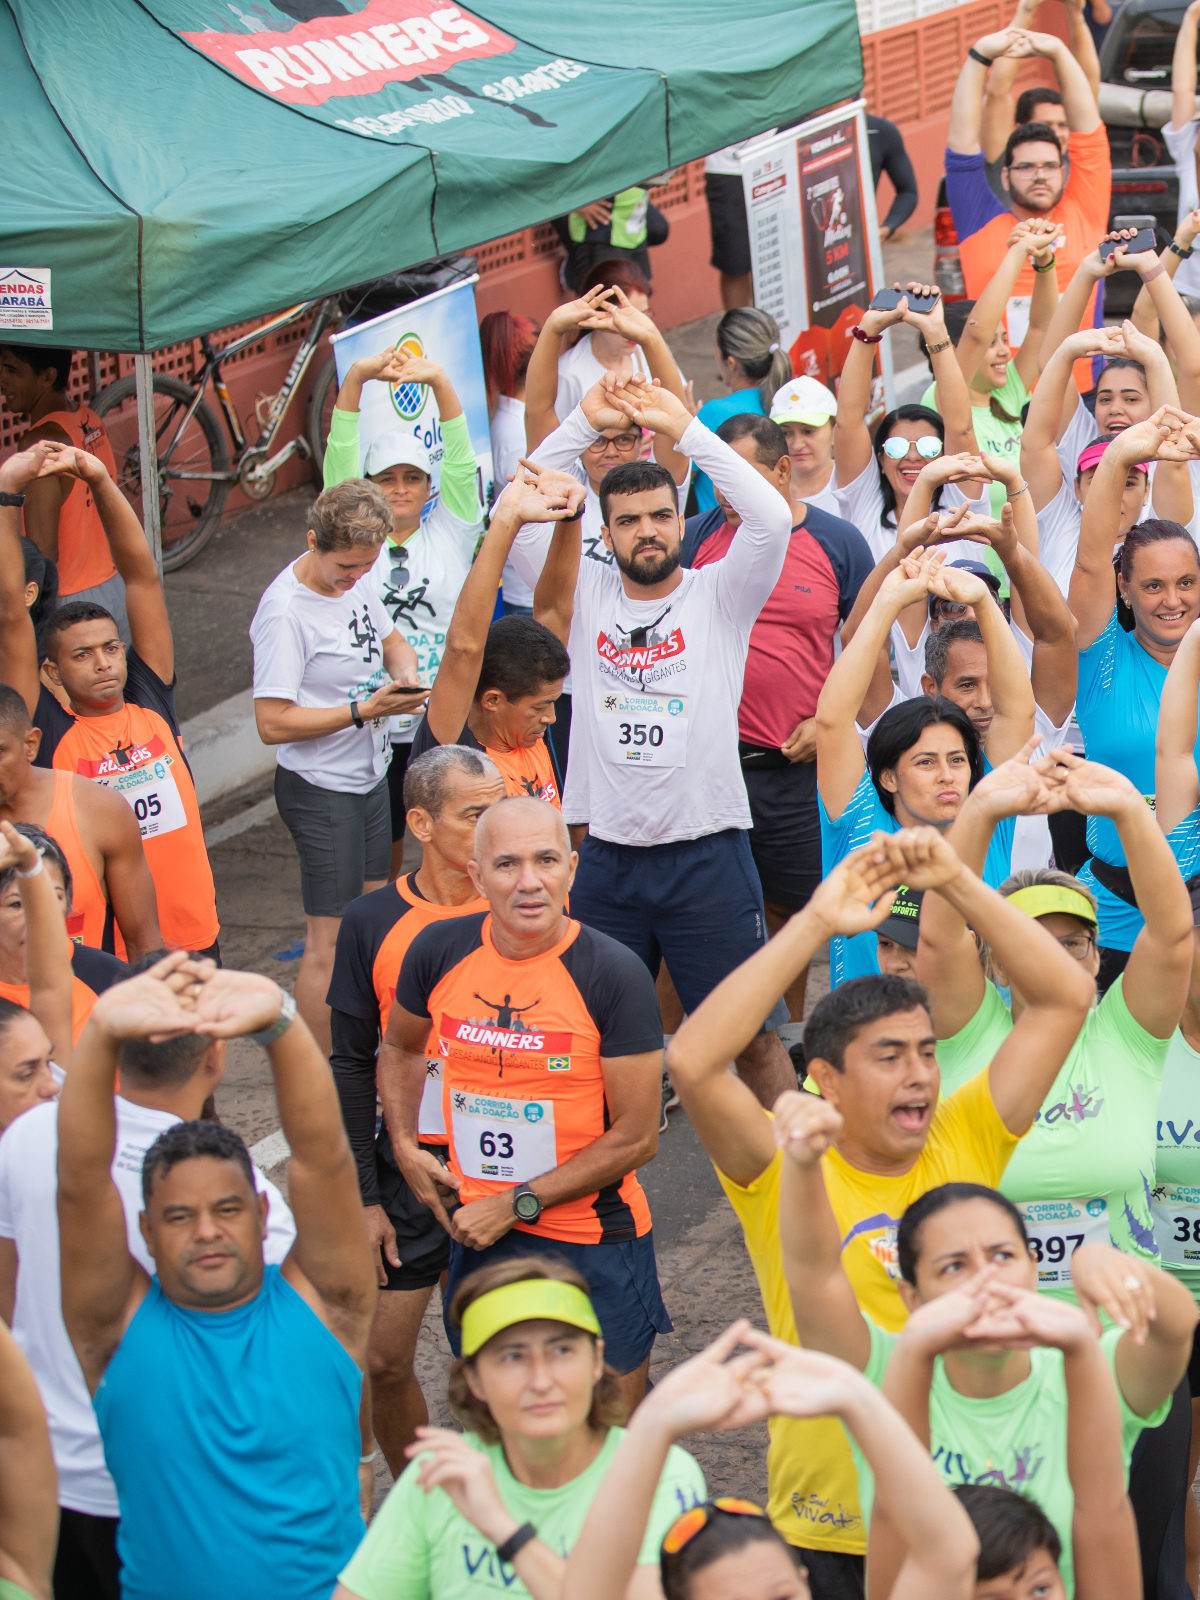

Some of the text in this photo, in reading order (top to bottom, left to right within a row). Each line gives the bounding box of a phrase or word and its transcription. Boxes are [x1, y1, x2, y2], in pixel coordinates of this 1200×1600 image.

[234, 7, 490, 92] RUNNERS
[0, 284, 44, 295] ENDAS
[0, 296, 46, 307] ARABÁ
[644, 659, 687, 684] GIGANTES
[624, 697, 659, 706] CORRIDA
[630, 703, 664, 714] DOAÇÃO
[618, 722, 664, 748] 350
[118, 769, 148, 784] CORRIDA
[455, 1023, 546, 1051] RUNNERS
[504, 1056, 546, 1071] GIGANTES
[474, 1098, 513, 1111] CORRIDA
[468, 1105, 520, 1119] DA DOAÇÃO
[479, 1130, 515, 1160] 63
[1170, 1193, 1183, 1202] DA
[1027, 1202, 1073, 1214] CORRIDA
[1037, 1209, 1082, 1222] DOAÇÃO
